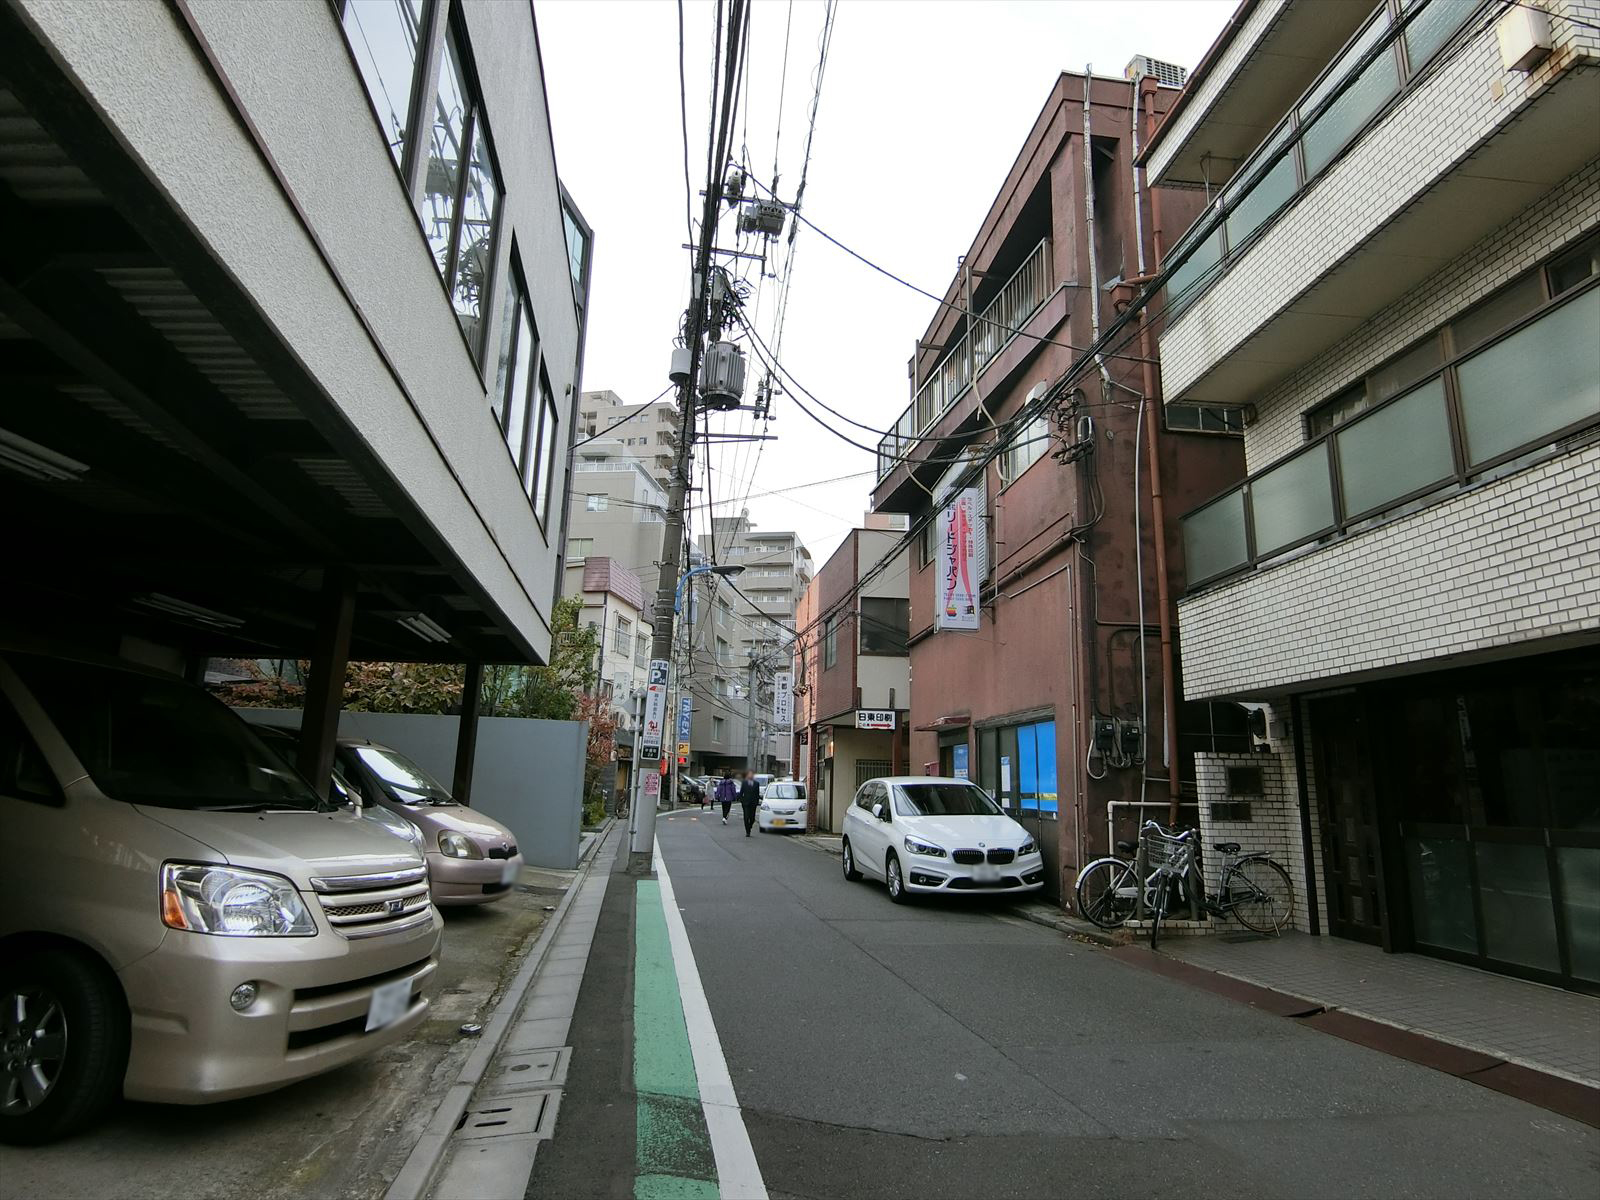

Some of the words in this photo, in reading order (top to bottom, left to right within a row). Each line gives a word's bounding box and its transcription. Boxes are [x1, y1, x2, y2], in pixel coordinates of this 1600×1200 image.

[946, 511, 958, 590] リードジャパン
[651, 670, 661, 683] P
[859, 712, 892, 722] 日東印刷
